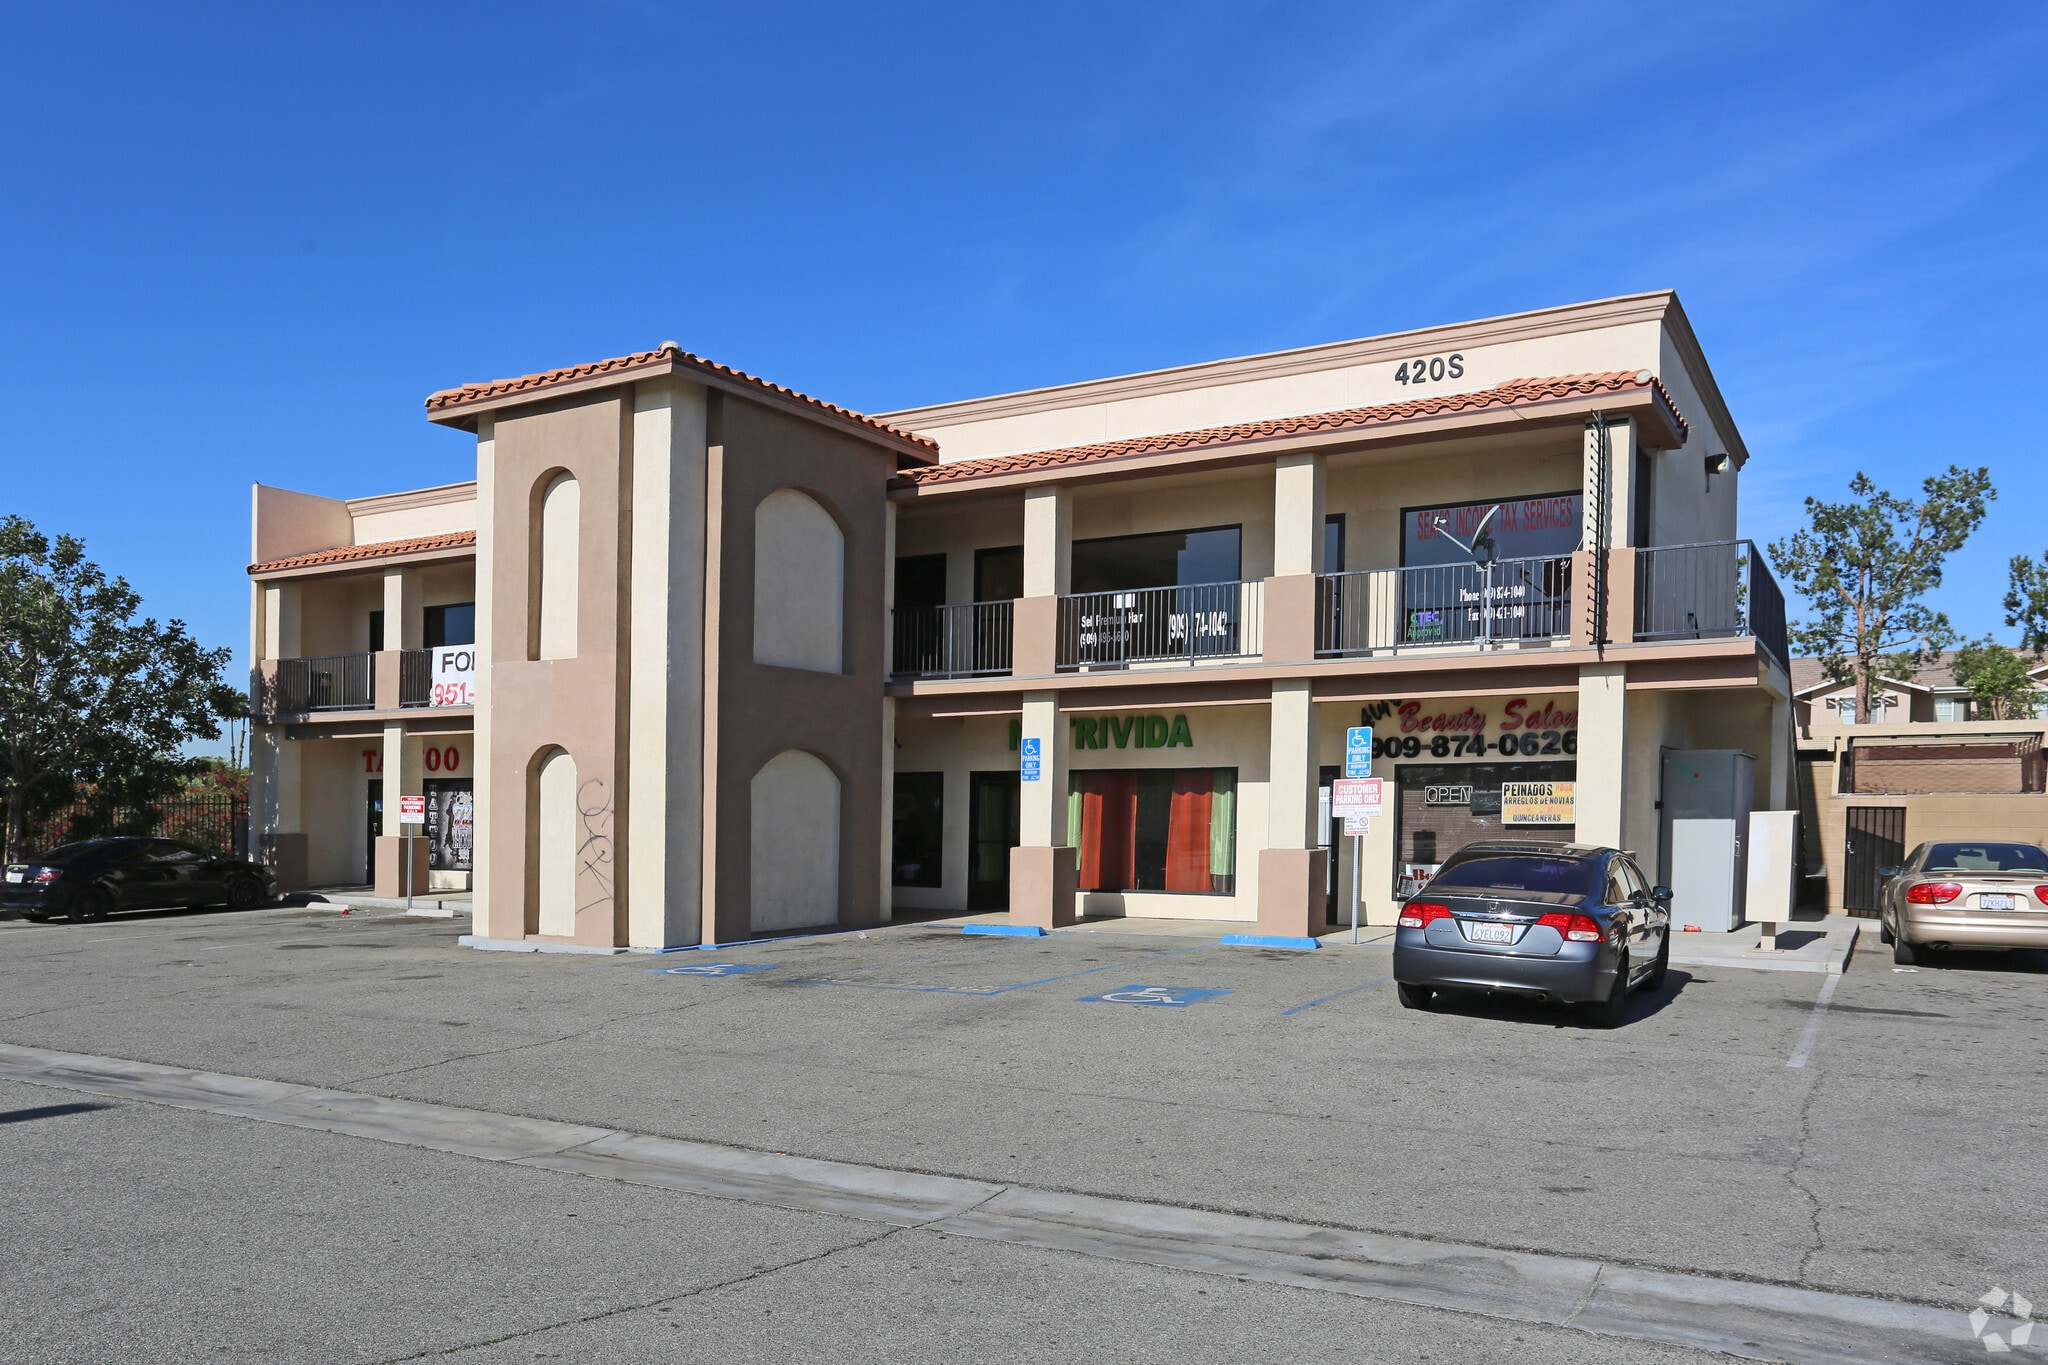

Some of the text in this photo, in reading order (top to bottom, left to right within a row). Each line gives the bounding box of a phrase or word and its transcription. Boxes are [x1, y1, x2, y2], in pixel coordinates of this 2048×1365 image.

[1395, 353, 1464, 386] 420S
[1500, 503, 1518, 533] TAX
[1523, 497, 1573, 531] SERVICES
[1081, 615, 1094, 628] Sel
[1128, 611, 1144, 624] Har
[1168, 610, 1228, 646] (909) 74-1042
[1398, 701, 1486, 741] Beauty
[1500, 698, 1578, 730] Salon
[1371, 730, 1578, 759] 909-874-0626
[1338, 784, 1379, 795] CUSTOMER
[1427, 787, 1471, 802] OPEN
[1503, 784, 1553, 797] PEINADOS
[1335, 793, 1380, 805] PARKING ONLY
[1503, 796, 1539, 805] ARREGLOS
[1539, 796, 1549, 805] DE
[1549, 796, 1575, 805] NOVIAS
